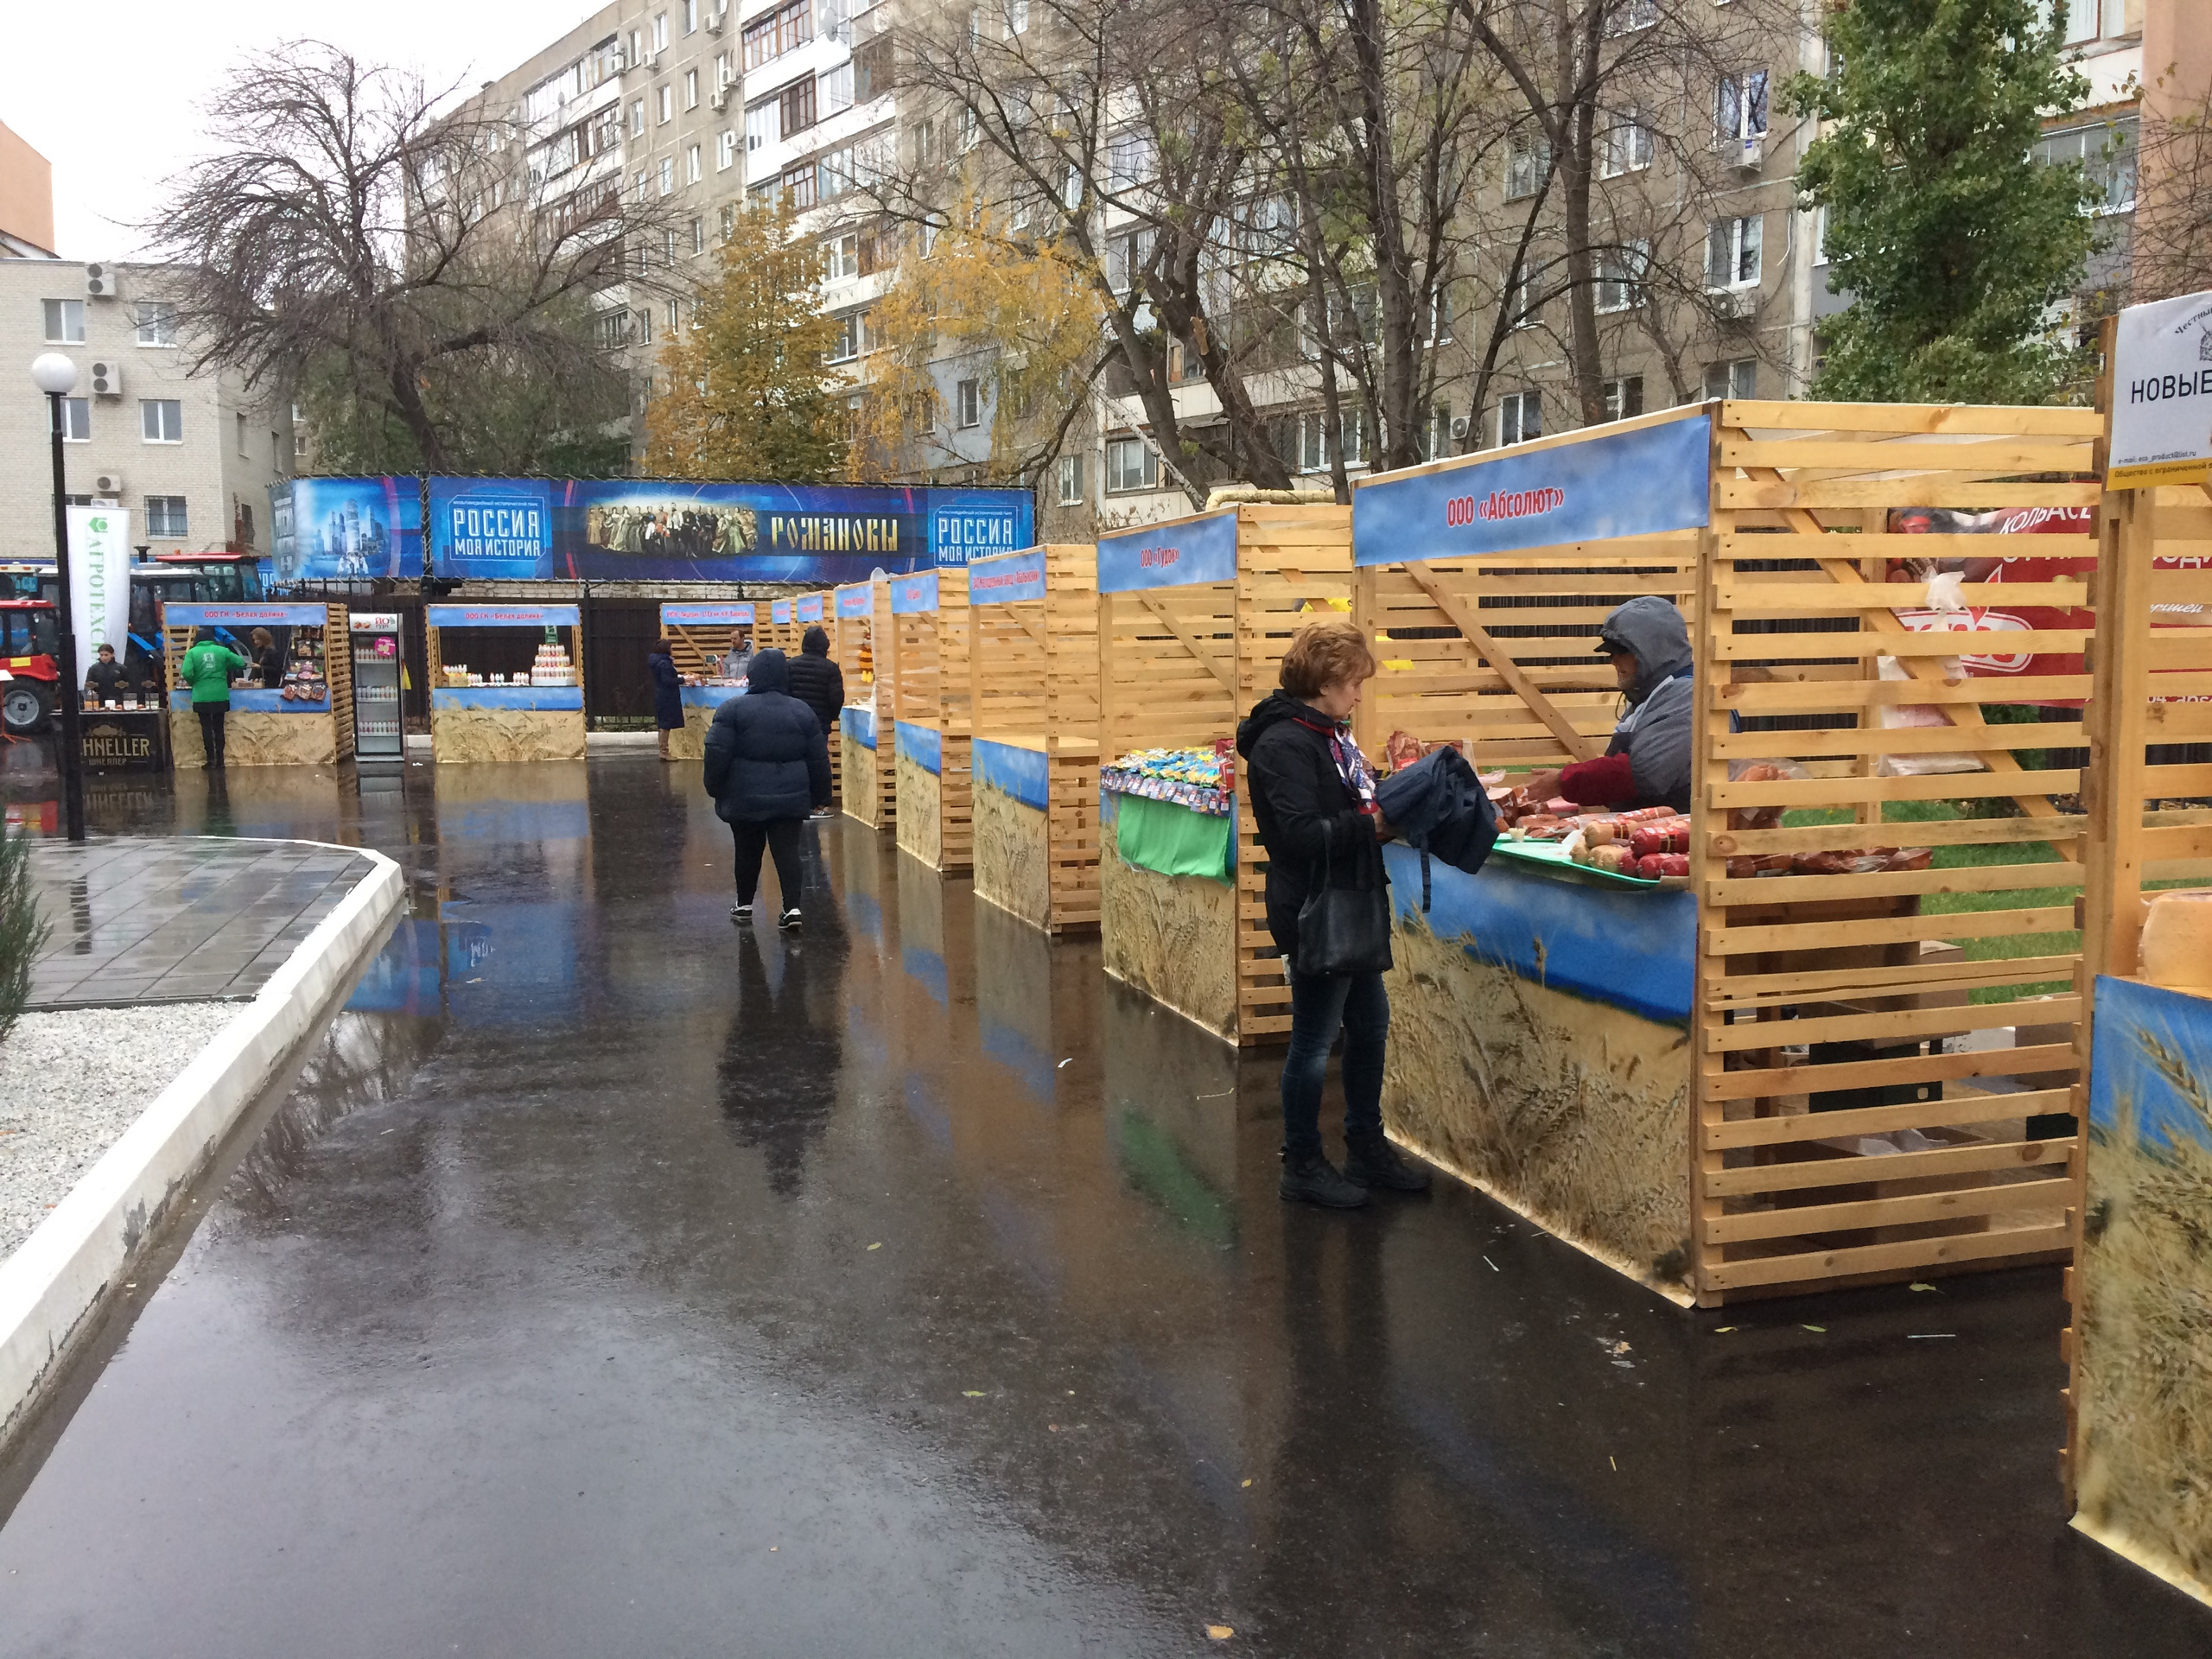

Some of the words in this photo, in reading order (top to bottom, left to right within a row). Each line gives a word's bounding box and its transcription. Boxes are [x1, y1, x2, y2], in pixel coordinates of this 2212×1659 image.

[2175, 308, 2212, 334] Честны
[2131, 369, 2212, 404] НОВЫЕ
[1447, 496, 1474, 527] ООО
[1478, 487, 1565, 521] «Абсолют»
[454, 508, 540, 537] РОССИЯ
[771, 517, 898, 552] РОМАНОВЫ
[938, 518, 1014, 545] РОССИЯ
[454, 537, 482, 556] МОЯ
[485, 538, 541, 556] ИСТОРИЯ
[938, 545, 963, 563] МОЯ
[1141, 549, 1153, 568] ООО
[82, 738, 150, 757] HNELLER
